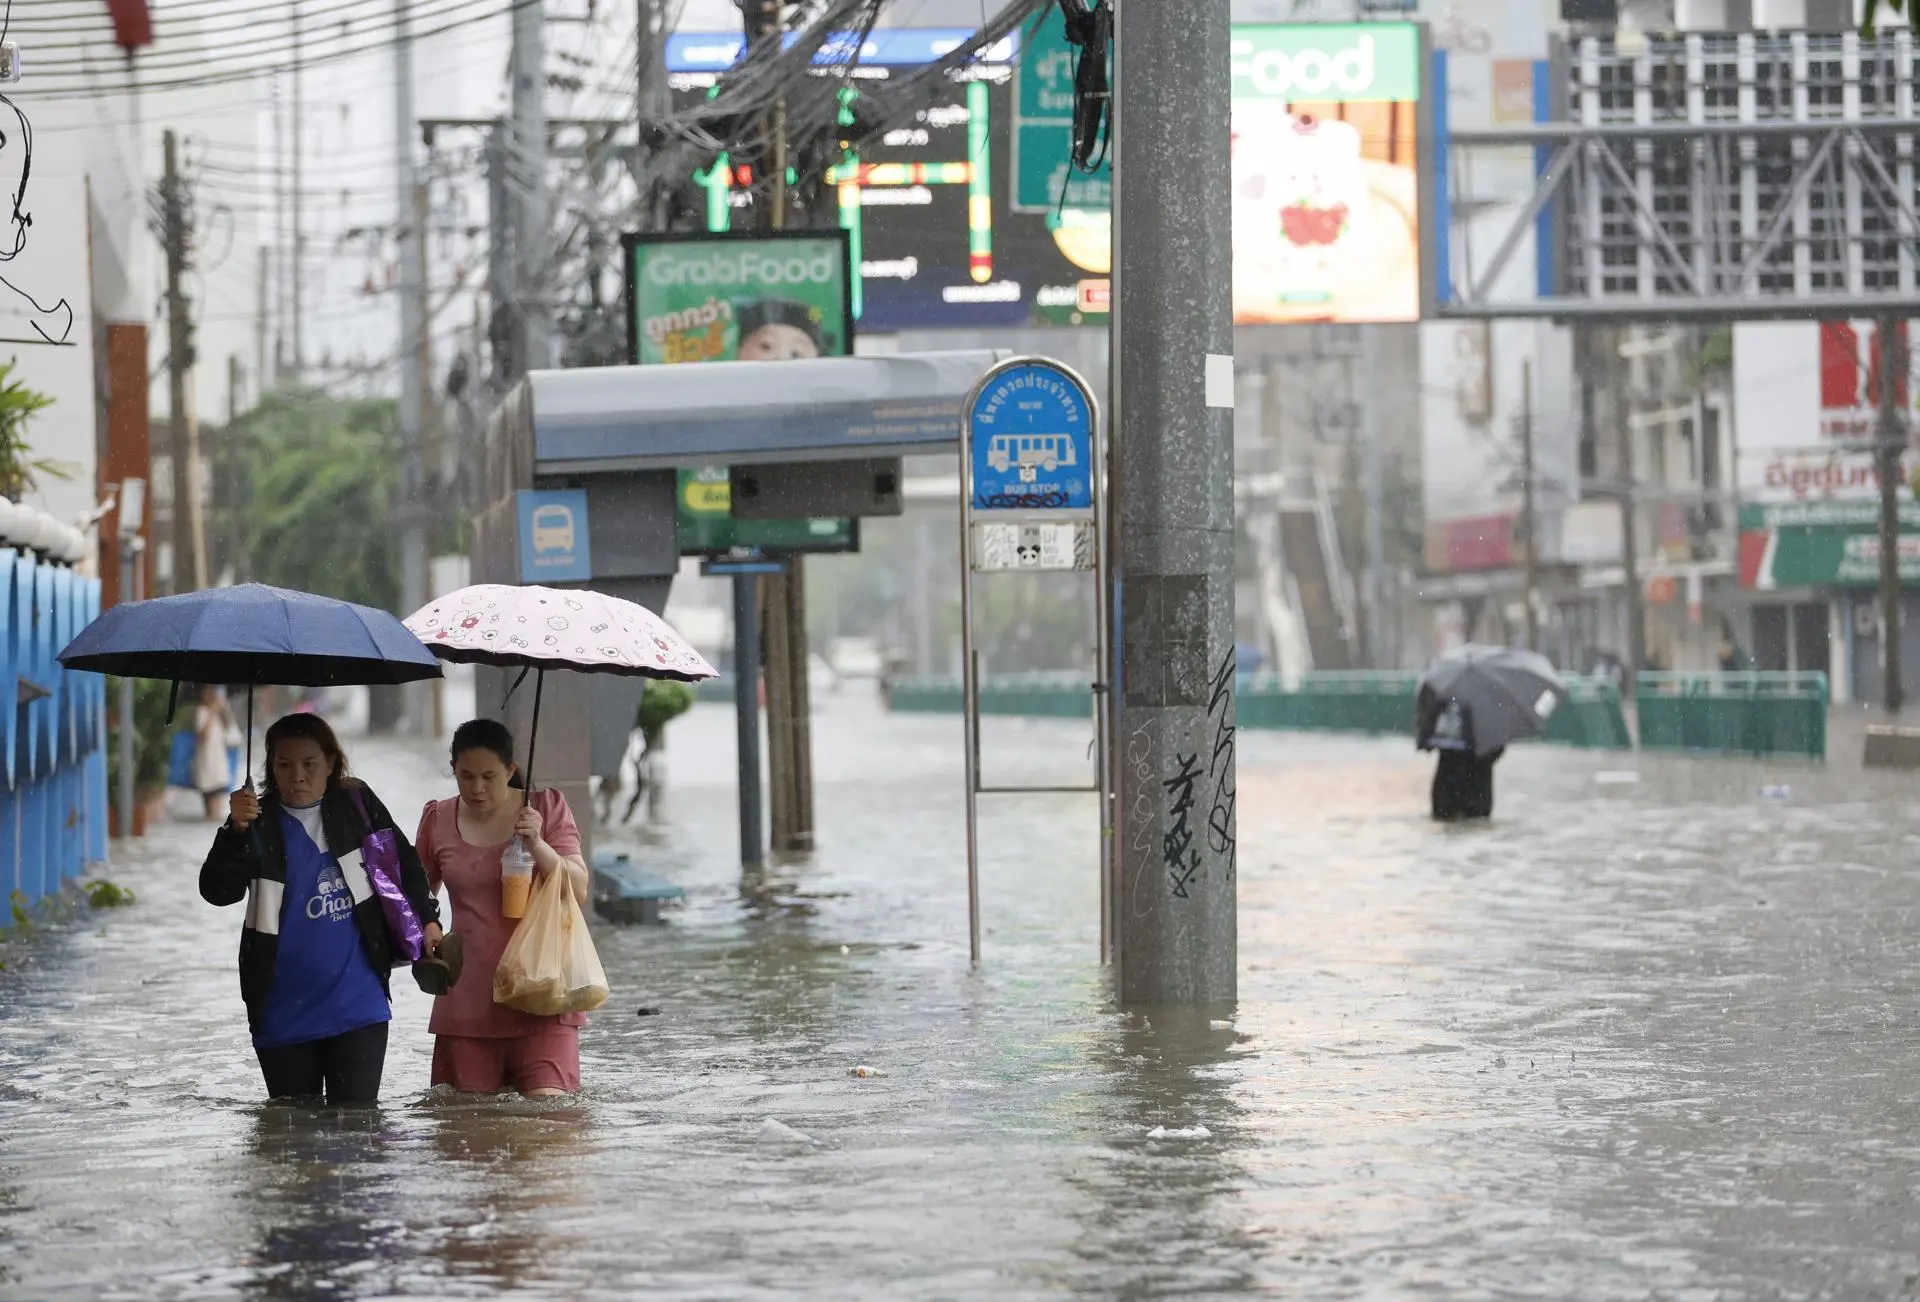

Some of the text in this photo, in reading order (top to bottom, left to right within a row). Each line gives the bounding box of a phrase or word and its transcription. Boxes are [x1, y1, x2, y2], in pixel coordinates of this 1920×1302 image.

[648, 252, 833, 285] GrabFood
[1004, 482, 1060, 494] BUS STOP
[331, 911, 352, 922] Beer
